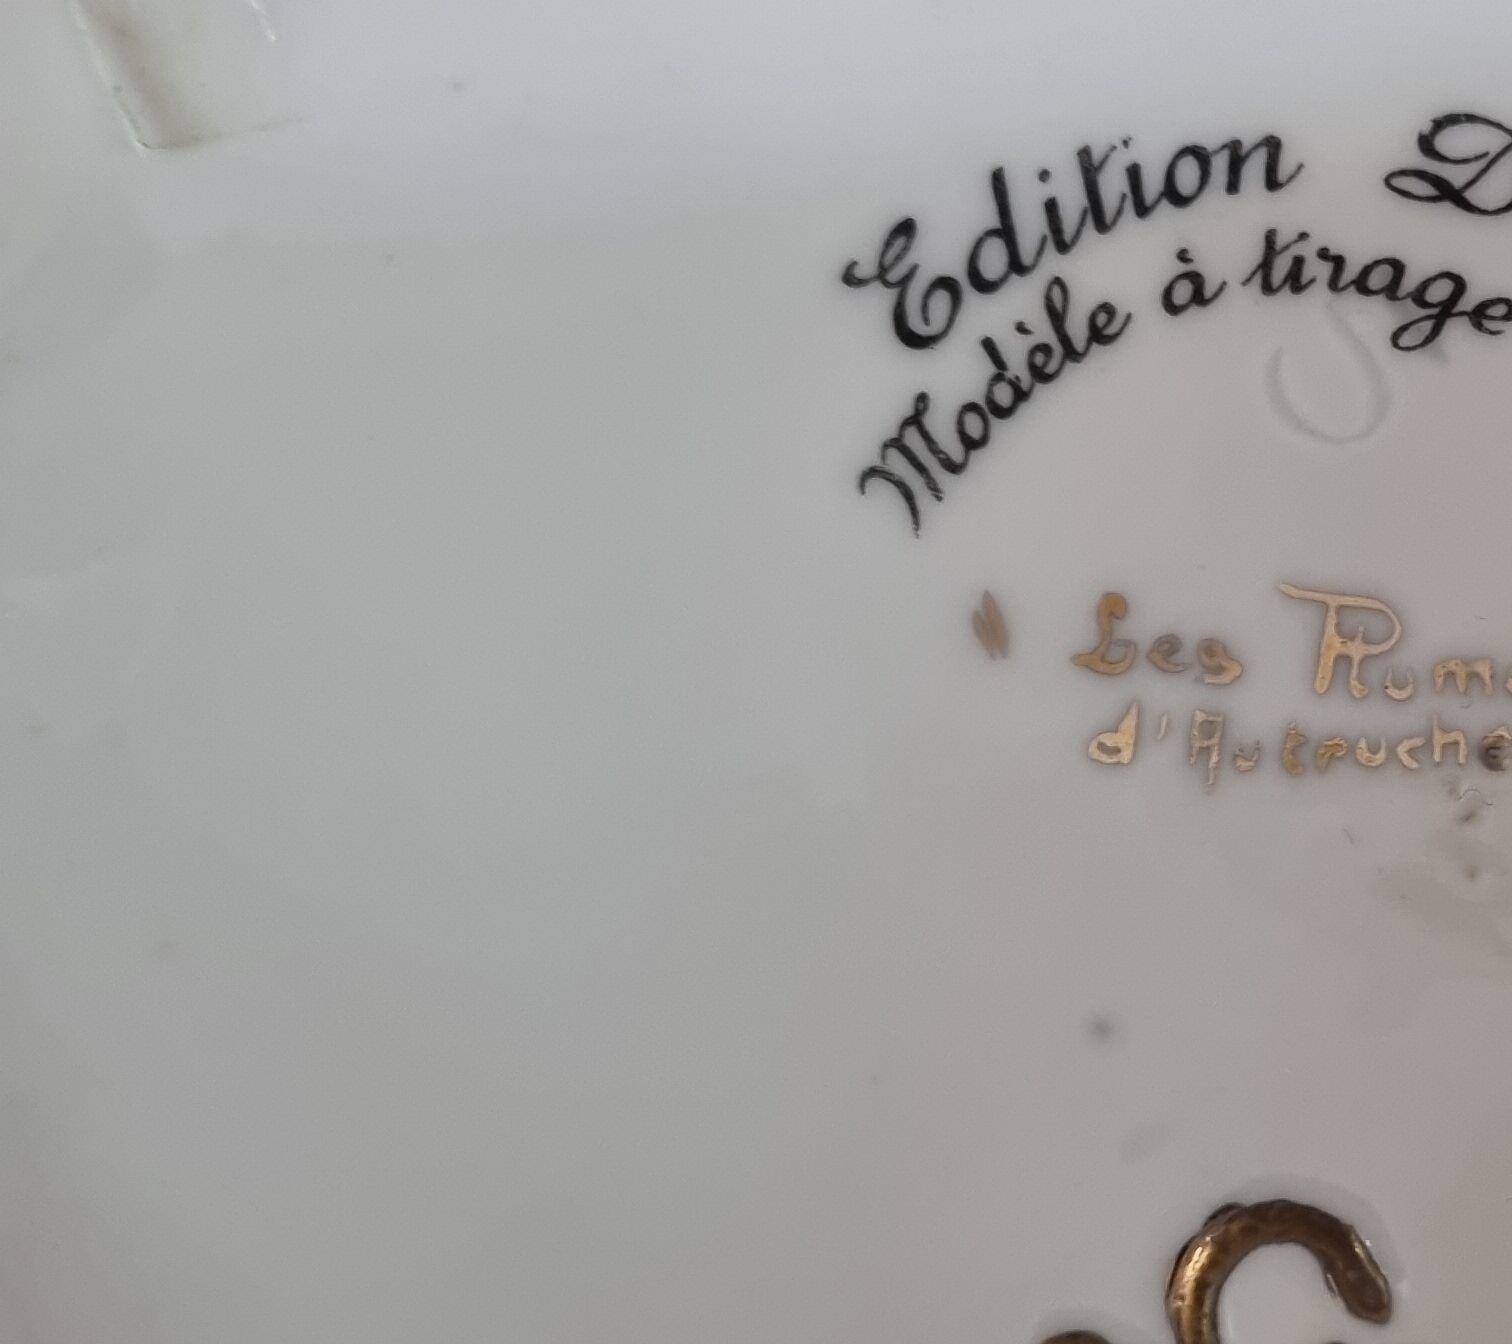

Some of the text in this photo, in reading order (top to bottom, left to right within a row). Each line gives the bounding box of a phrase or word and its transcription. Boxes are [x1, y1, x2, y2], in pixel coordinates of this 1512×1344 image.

[840, 131, 1304, 352] Edition
[858, 274, 1132, 540] Modèle
[1160, 247, 1228, 318] à
